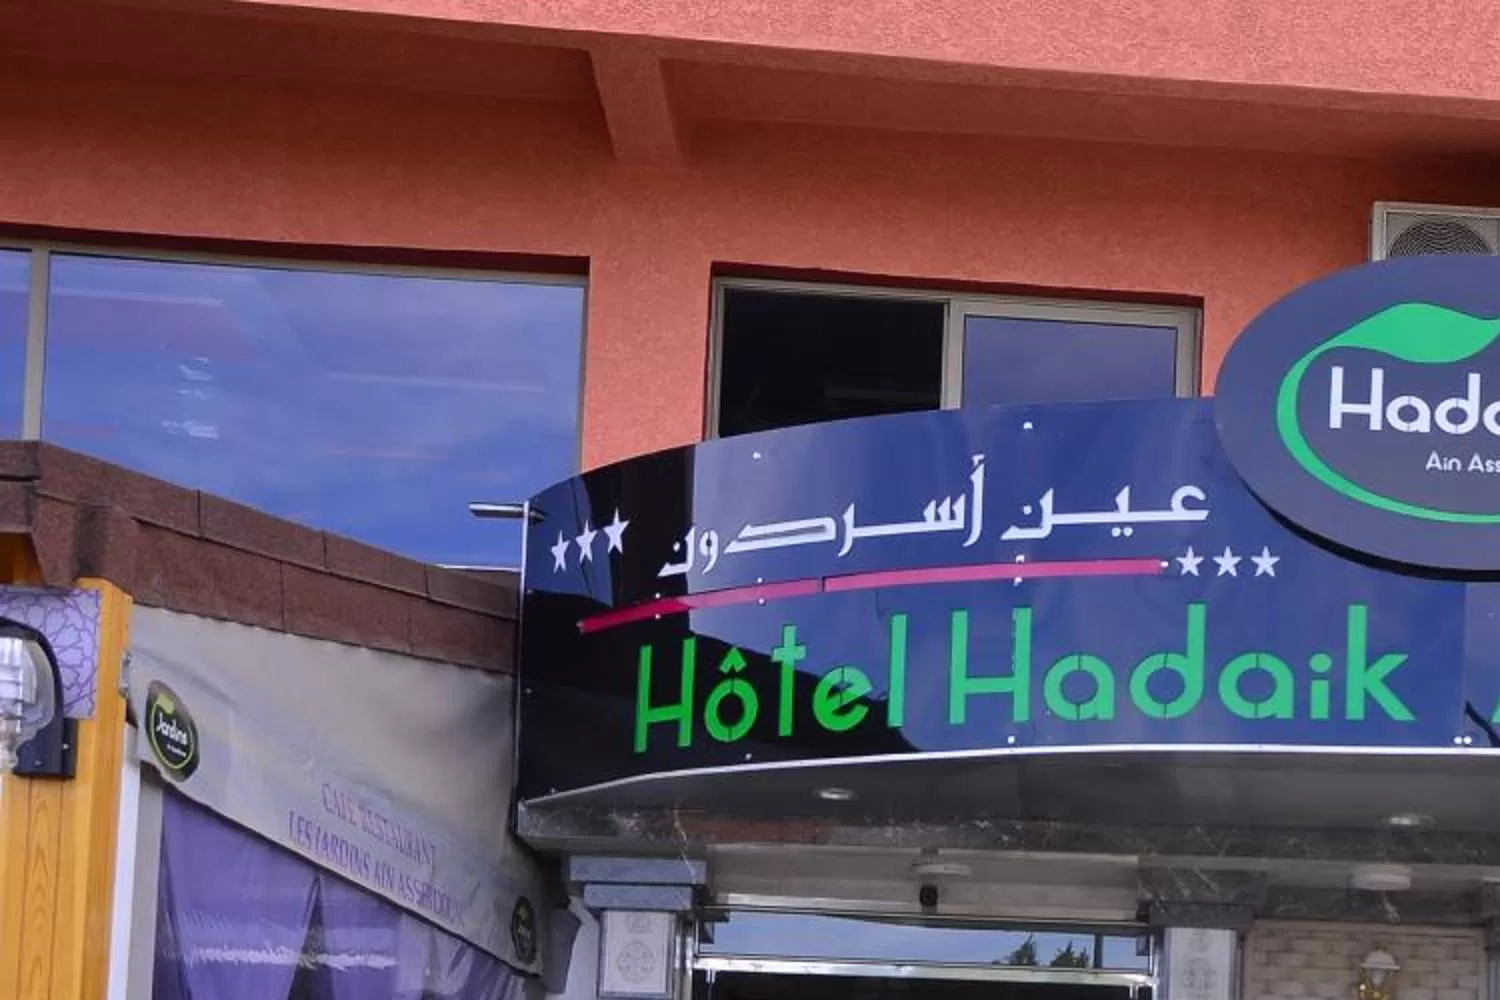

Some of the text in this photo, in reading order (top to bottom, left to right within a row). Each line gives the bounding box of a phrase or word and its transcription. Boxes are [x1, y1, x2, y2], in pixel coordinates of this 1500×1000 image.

[1425, 450, 1462, 472] Ain
[656, 454, 986, 578] أسردون
[1000, 484, 1210, 542] عين
[633, 612, 908, 753] Hôtel
[947, 602, 1414, 725] Hadaik
